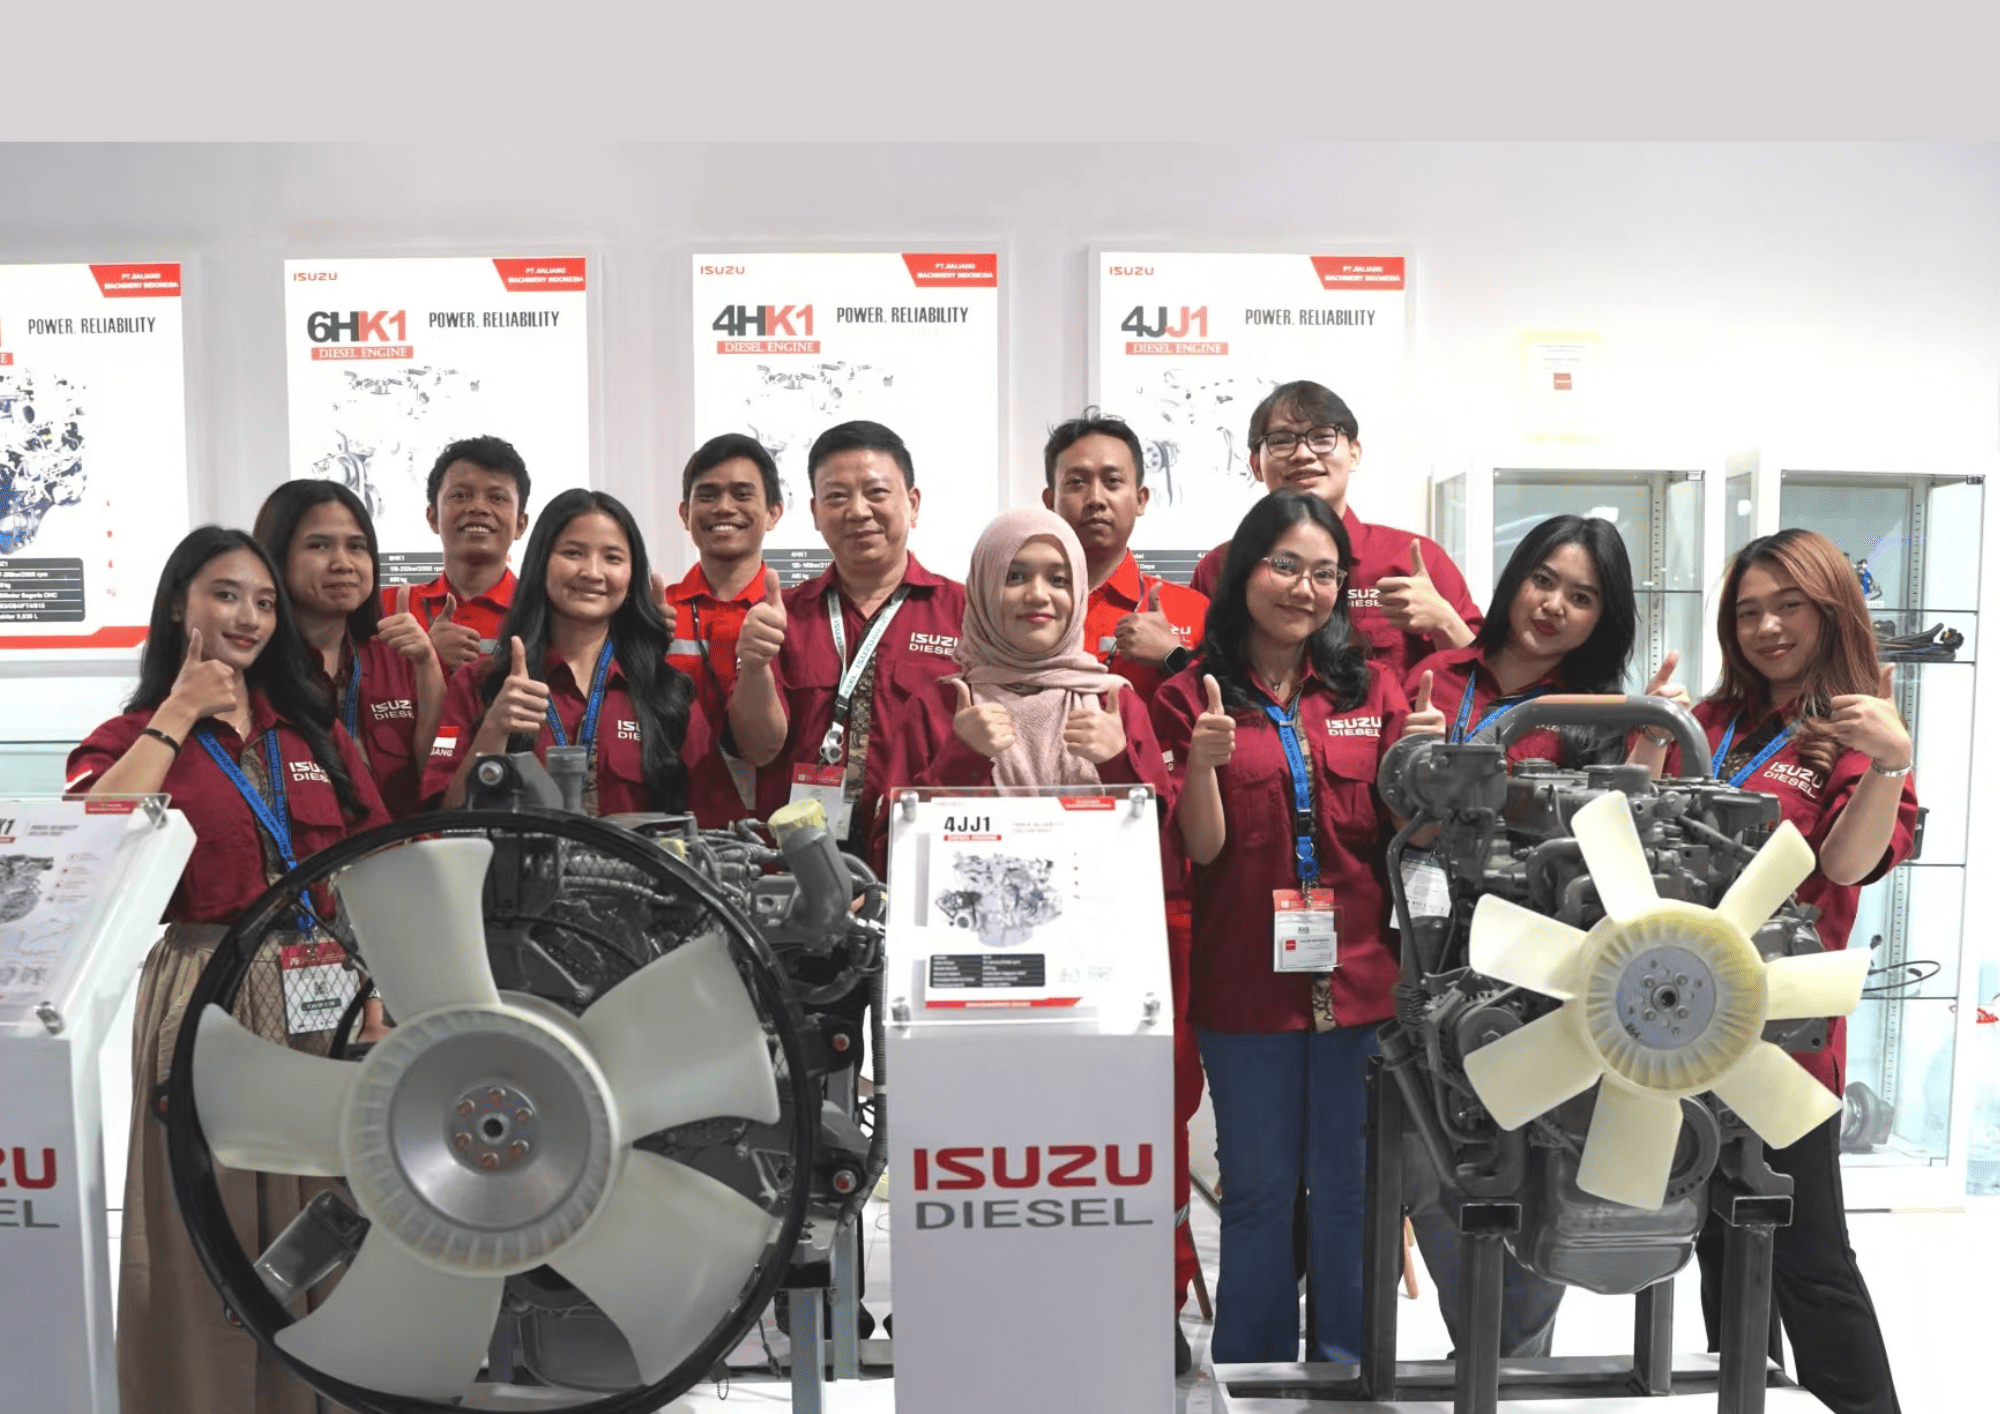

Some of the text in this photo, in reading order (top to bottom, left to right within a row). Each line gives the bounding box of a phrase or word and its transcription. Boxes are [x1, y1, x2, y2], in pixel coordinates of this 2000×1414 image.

[293, 272, 338, 281] ISUZU
[700, 265, 745, 275] ISUZU
[1109, 266, 1154, 276] ISUZU
[429, 310, 560, 328] POWER. RELIABILITY
[712, 304, 814, 337] 4HK1
[836, 307, 969, 323] POWER. RELIABILITY
[1121, 305, 1208, 338] 4JJ1
[1245, 309, 1376, 326] POWER. RELIABILITY
[28, 316, 156, 335] POWER. RELIABILITY
[307, 309, 406, 343] 6HK1
[320, 346, 408, 358] DIESEL ENGINE
[724, 342, 815, 352] DIESEL ENGINE
[1133, 343, 1222, 353] DIESEL ENGINE
[1348, 588, 1381, 599] SUZ
[908, 643, 955, 656] DIESE
[370, 699, 412, 713] ISUZ
[1325, 716, 1382, 729] ISUZU
[1328, 728, 1380, 737] DIESEL
[1769, 761, 1824, 789] ISUZU
[1763, 769, 1817, 799] DIESEL
[943, 816, 991, 832] 4JJ1
[913, 1143, 1154, 1192] ISUZU
[915, 1197, 1154, 1230] DIESEL
